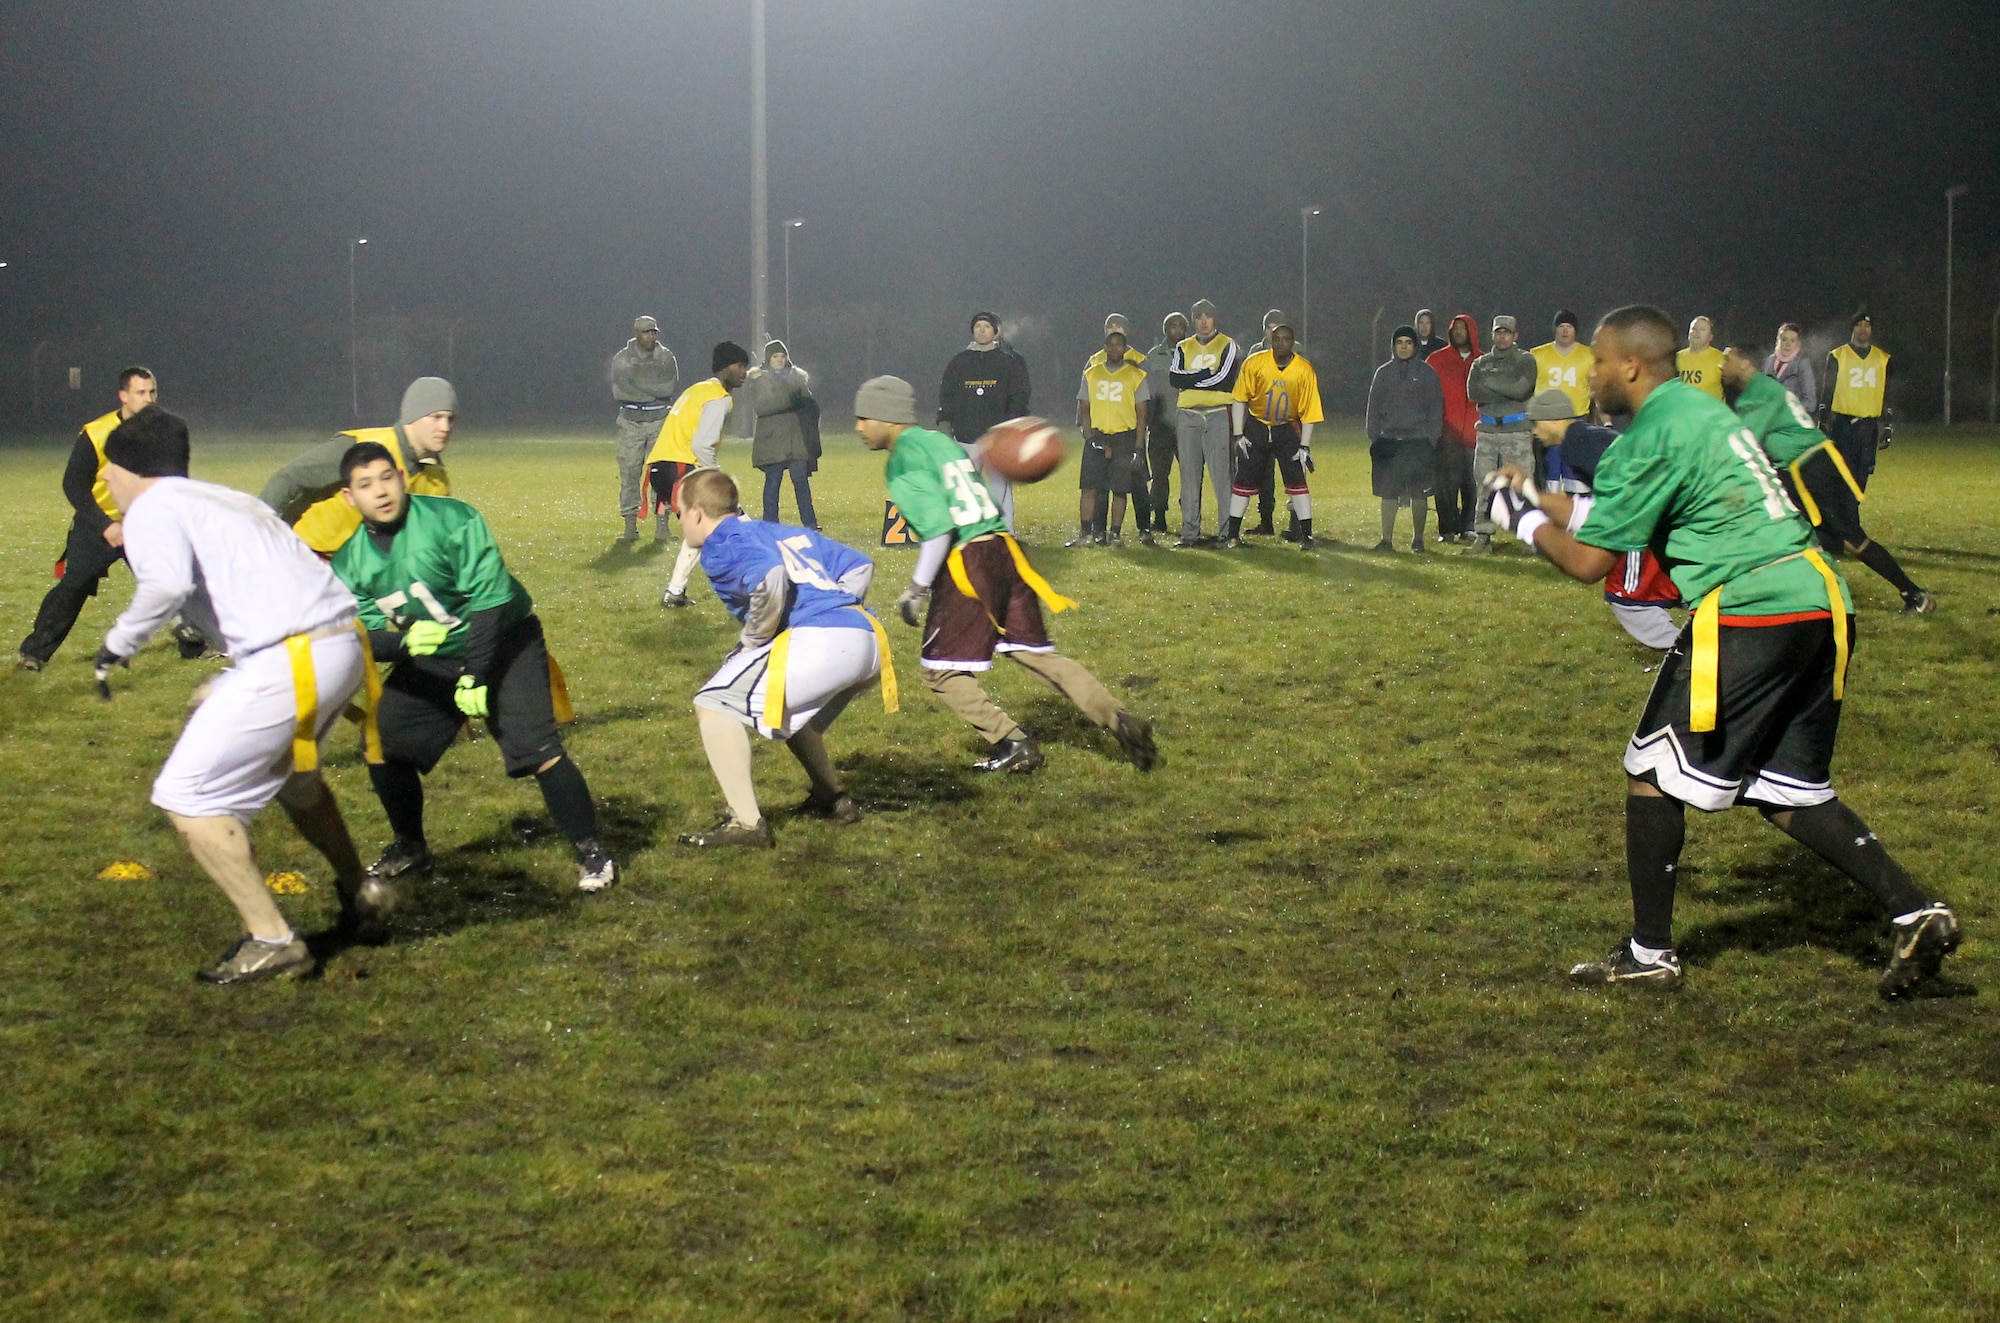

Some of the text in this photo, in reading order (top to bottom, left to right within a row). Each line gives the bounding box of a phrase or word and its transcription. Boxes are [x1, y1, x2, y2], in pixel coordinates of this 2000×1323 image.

[1191, 353, 1217, 369] 42
[1548, 366, 1577, 387] 34
[1849, 367, 1876, 388] 24
[1095, 380, 1124, 402] 32
[1265, 389, 1289, 424] 10
[942, 458, 999, 526] 35
[776, 534, 840, 591] 45
